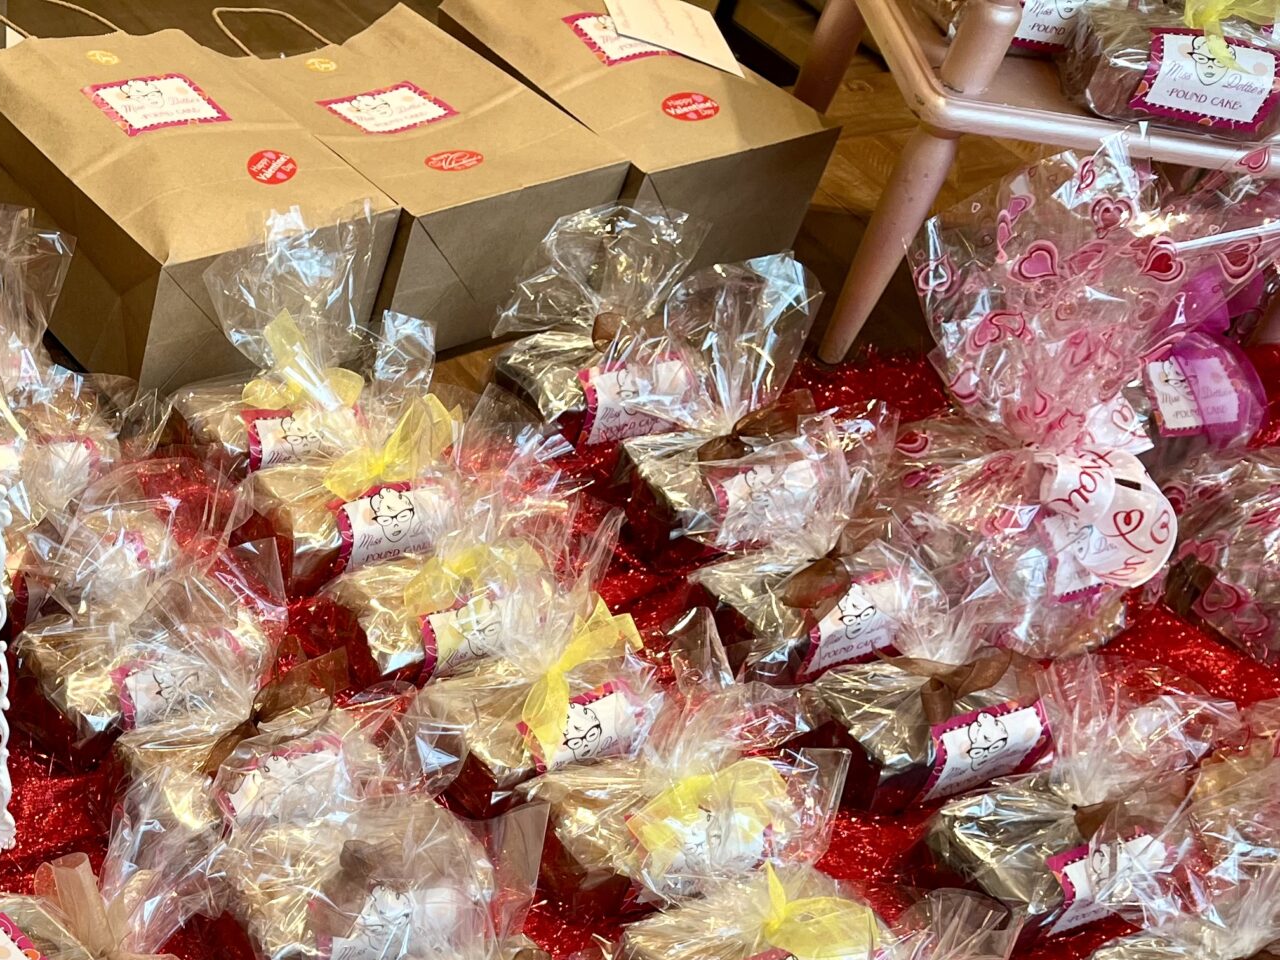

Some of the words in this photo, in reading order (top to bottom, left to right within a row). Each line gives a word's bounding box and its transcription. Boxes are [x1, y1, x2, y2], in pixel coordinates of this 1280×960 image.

[1028, 2, 1054, 17] Miss
[1032, 22, 1067, 36] POUND
[1166, 60, 1194, 80] Miss
[1222, 73, 1267, 95] Dottie's
[1169, 88, 1208, 103] POUND
[1210, 97, 1241, 110] CAKE
[359, 533, 383, 550] Miss
[365, 549, 401, 563] POUND
